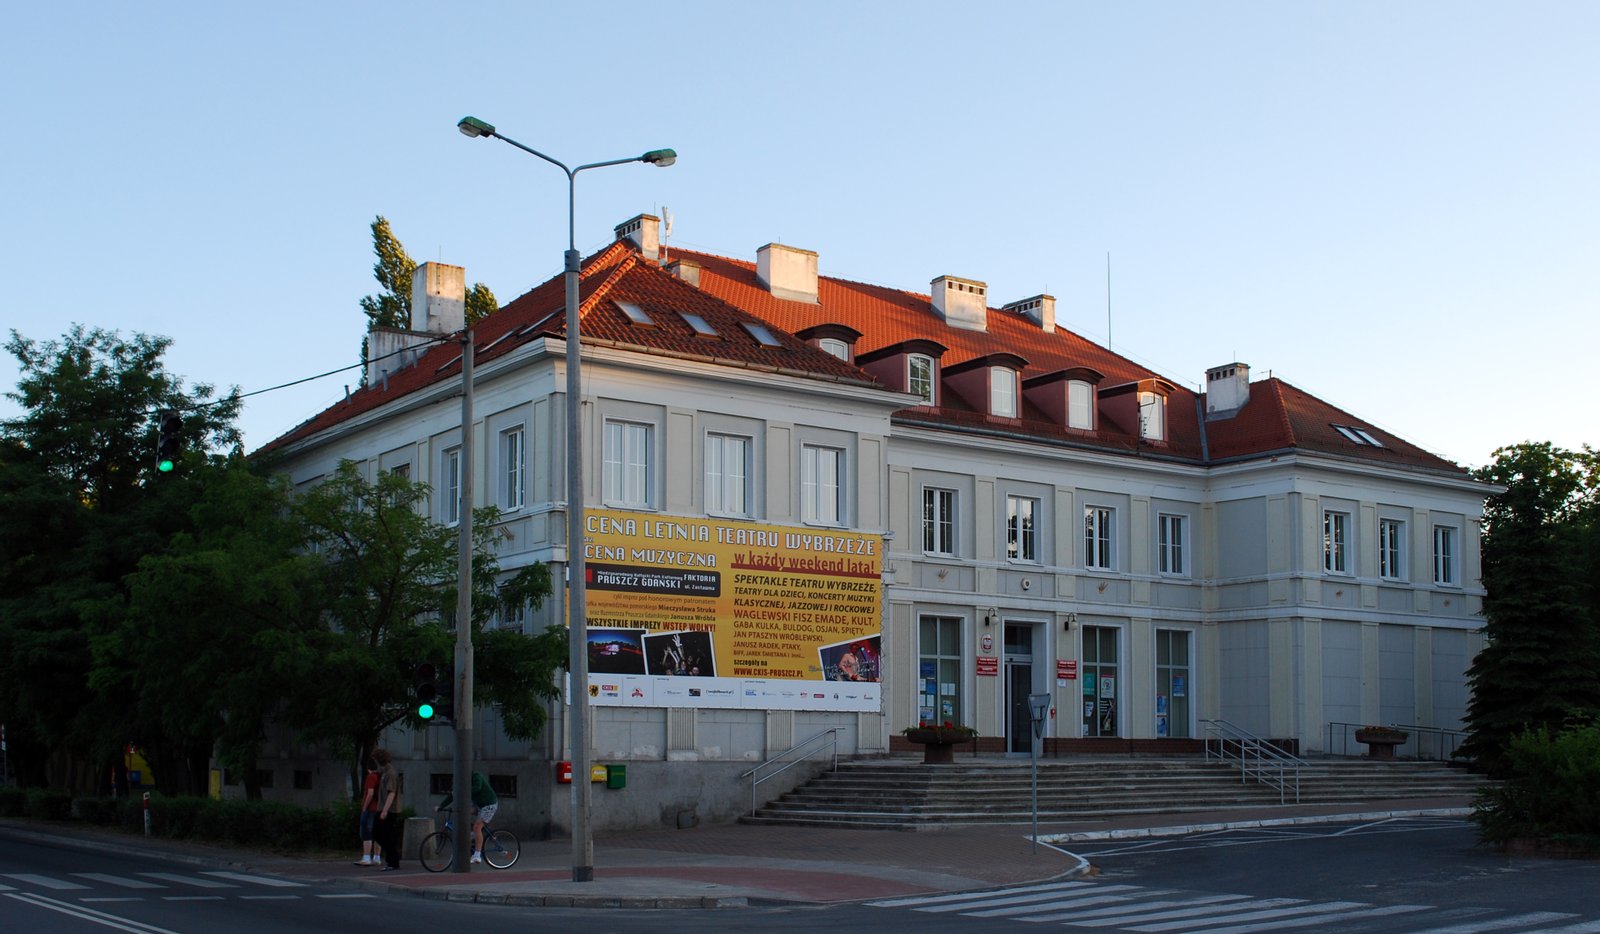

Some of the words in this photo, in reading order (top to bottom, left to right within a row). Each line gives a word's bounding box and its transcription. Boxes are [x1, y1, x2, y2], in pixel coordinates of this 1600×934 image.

[586, 516, 636, 536] CENA
[644, 520, 709, 542] LETNIA
[716, 527, 778, 548] TEATRU
[786, 533, 875, 556] WYBRZEŻE
[584, 545, 625, 561] CENA
[632, 549, 716, 568] MUZYCZNA
[734, 553, 745, 565] w
[749, 551, 785, 571] każdy
[789, 556, 843, 572] weekend
[848, 558, 874, 574] lata!
[598, 575, 638, 586] PRUSZCZ
[684, 574, 716, 583] FAKTORIA
[734, 574, 789, 587] SPEKTAKLE
[790, 578, 824, 589] TEATRU
[826, 580, 877, 593] WYBRZEŻE,
[648, 596, 682, 604] honorowym
[735, 587, 762, 596] TEATRY
[763, 589, 780, 597] DLA
[780, 590, 806, 599] DZIECI,
[808, 592, 845, 601] KONCERTY
[847, 594, 874, 603] MUZYKI
[658, 604, 695, 613] Mieczysława
[734, 598, 786, 609] KLASYCZNEJ,
[787, 602, 828, 612] JAZZOWEJ
[833, 605, 875, 614] ROCKOWEJ
[586, 618, 628, 628] WSZYSTKIE
[630, 620, 661, 630] IMPREZY
[663, 622, 688, 631] WSTĘP
[733, 609, 790, 621] WAGLEWSKI
[794, 613, 812, 622] FISZ
[815, 614, 849, 626] EMADE,
[851, 616, 875, 627] KULT,
[755, 623, 781, 631] KULKA,
[783, 624, 814, 633] BULDOG,
[816, 626, 840, 634] OSJAN,
[734, 668, 803, 677] WWW.CKIS-PRUSZCZ.PL
